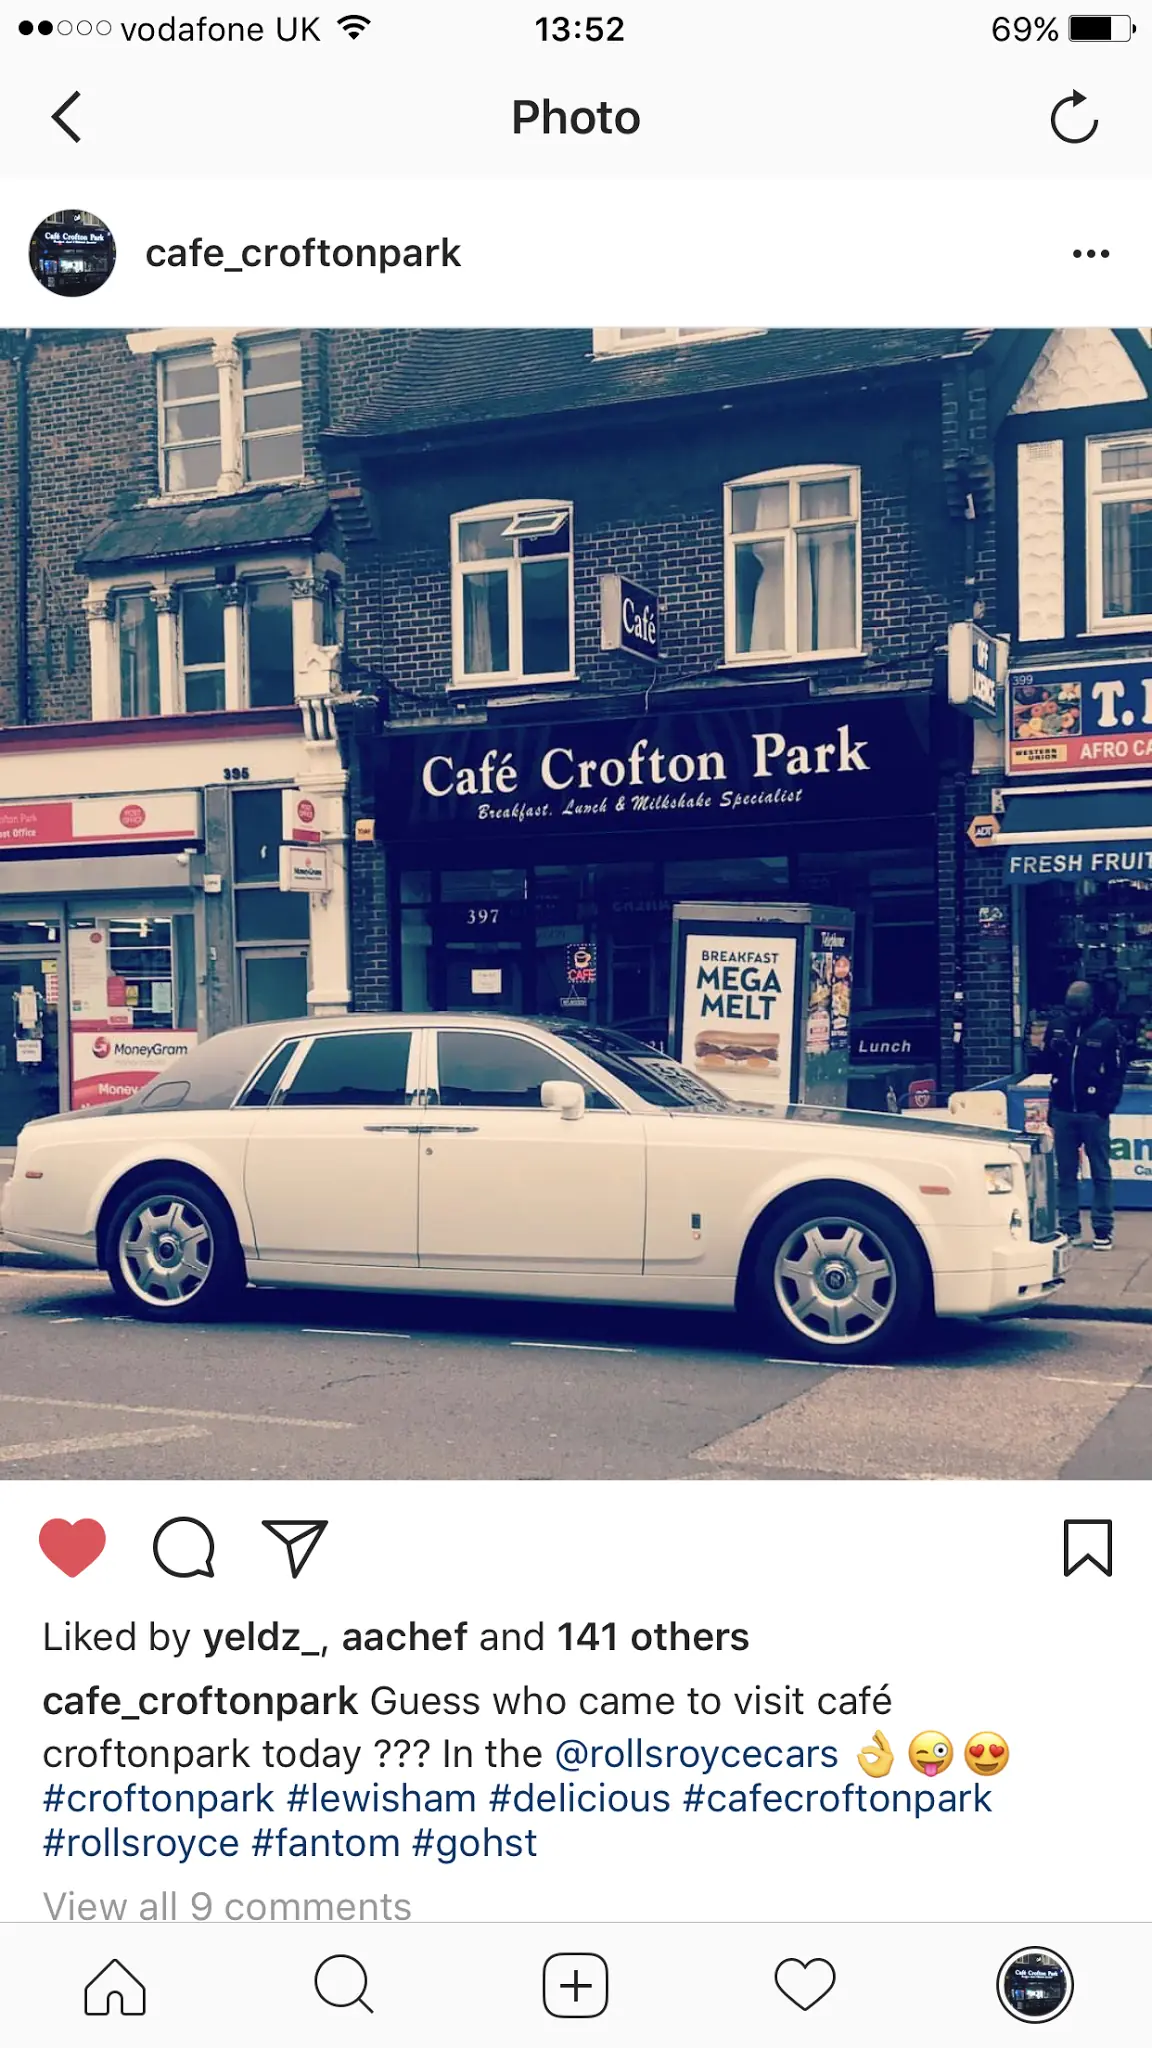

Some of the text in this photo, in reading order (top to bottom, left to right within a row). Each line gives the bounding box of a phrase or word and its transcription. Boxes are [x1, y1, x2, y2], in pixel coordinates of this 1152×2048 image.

[623, 598, 656, 645] Café
[1012, 675, 1034, 686] 399
[1015, 748, 1057, 756] WESTERN
[1028, 754, 1057, 762] UNION
[1080, 740, 1129, 761] AFRO
[422, 724, 871, 798] Café Crofton Park
[223, 767, 249, 781] 395
[562, 795, 608, 816] Lunch
[615, 796, 626, 812] &
[631, 788, 712, 812] Milkshake
[720, 788, 804, 809] Specialist
[12, 827, 37, 838] Office
[1010, 854, 1082, 874] FRESH
[467, 909, 499, 925] 397
[701, 949, 780, 964] BREAKFAST
[567, 968, 596, 982] CAFE
[696, 965, 783, 994] MEGA
[700, 993, 777, 1020] MELT
[114, 1043, 188, 1058] MoneyGram
[859, 1039, 912, 1054] Lunch
